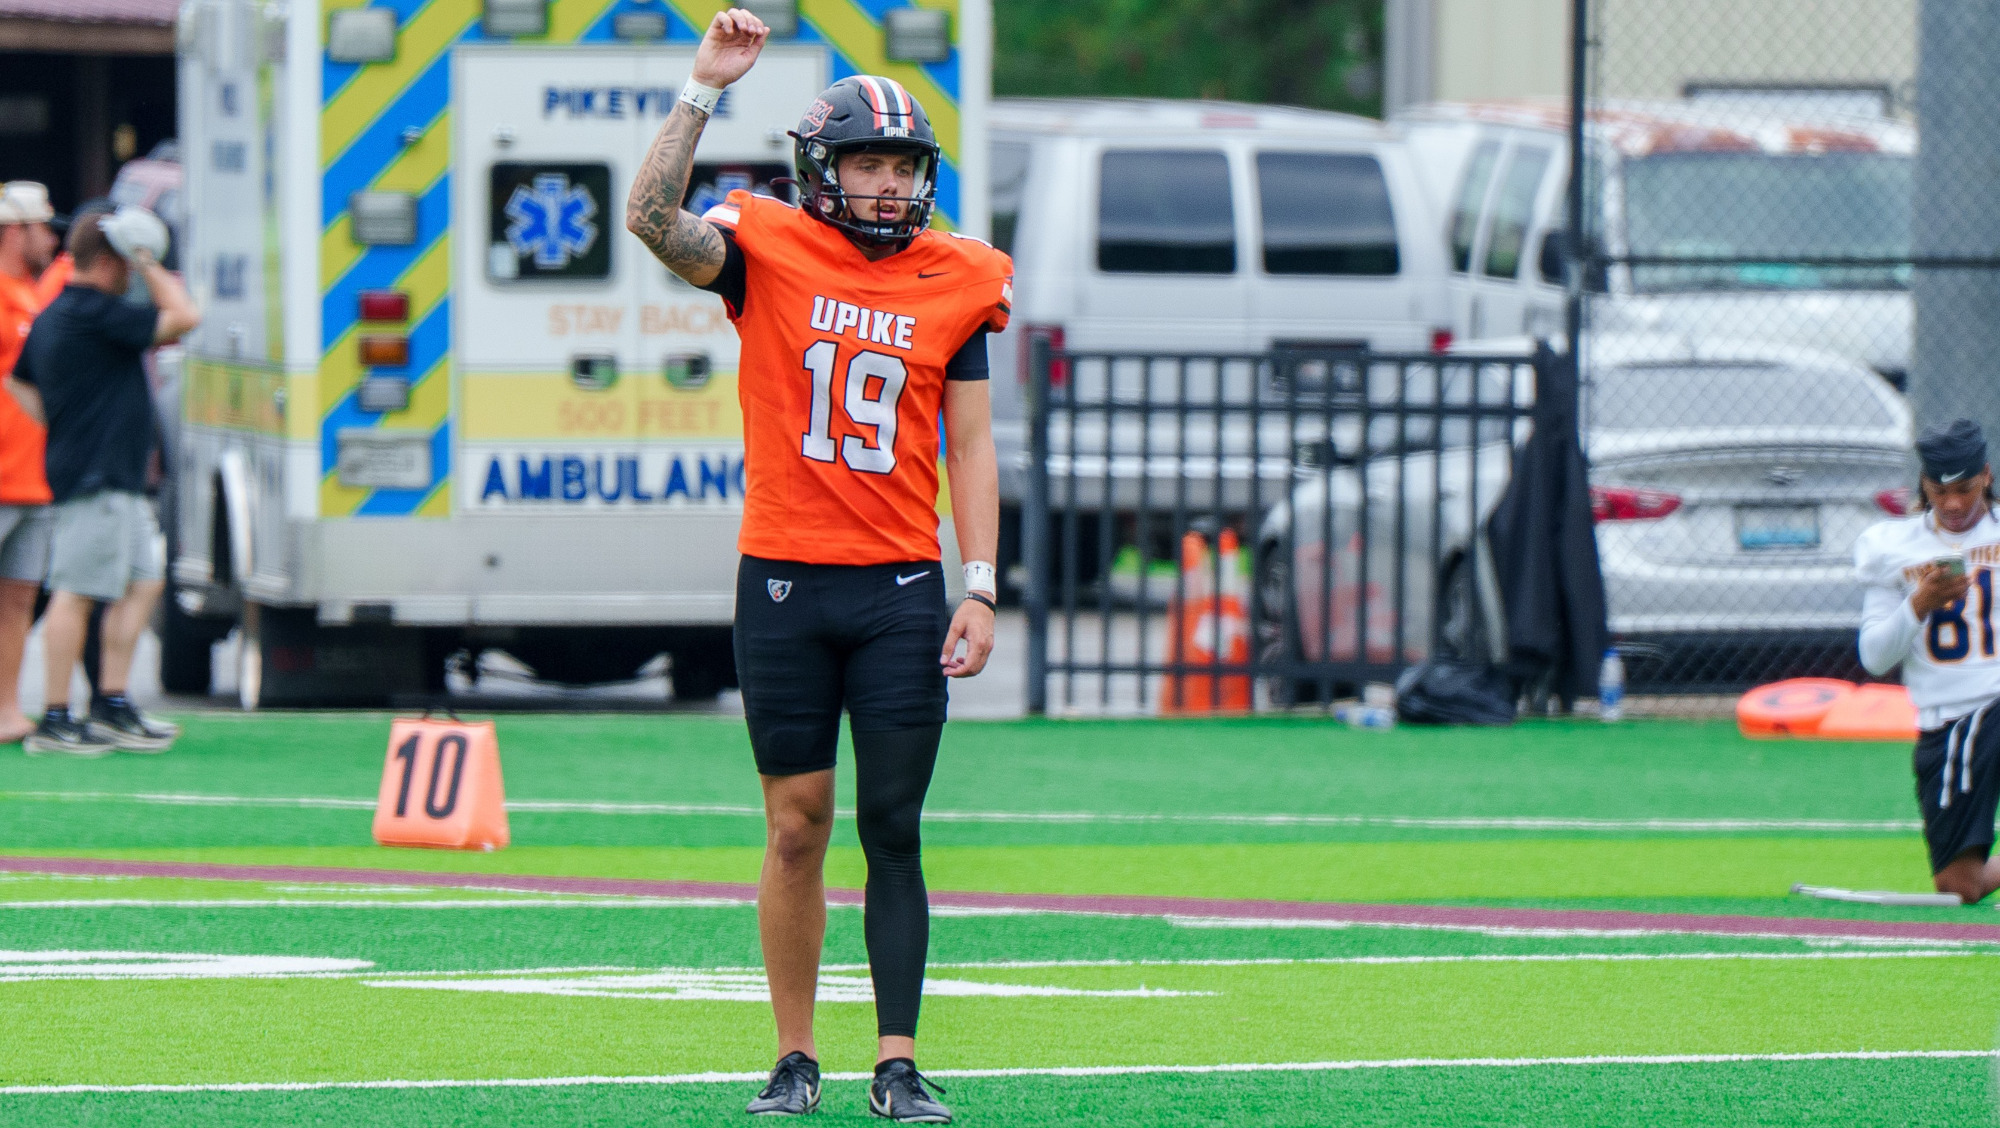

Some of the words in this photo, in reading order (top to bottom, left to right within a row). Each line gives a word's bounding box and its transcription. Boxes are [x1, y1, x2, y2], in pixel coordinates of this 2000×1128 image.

[543, 87, 733, 118] PIKEVIE
[883, 126, 909, 137] UPIKE
[549, 305, 626, 336] STAY
[640, 305, 730, 335] BACK
[810, 295, 916, 350] UPIKE
[558, 400, 626, 432] 500
[637, 399, 721, 431] FEET
[801, 339, 909, 475] 19
[1926, 566, 1996, 663] 81
[394, 731, 468, 820] 10
